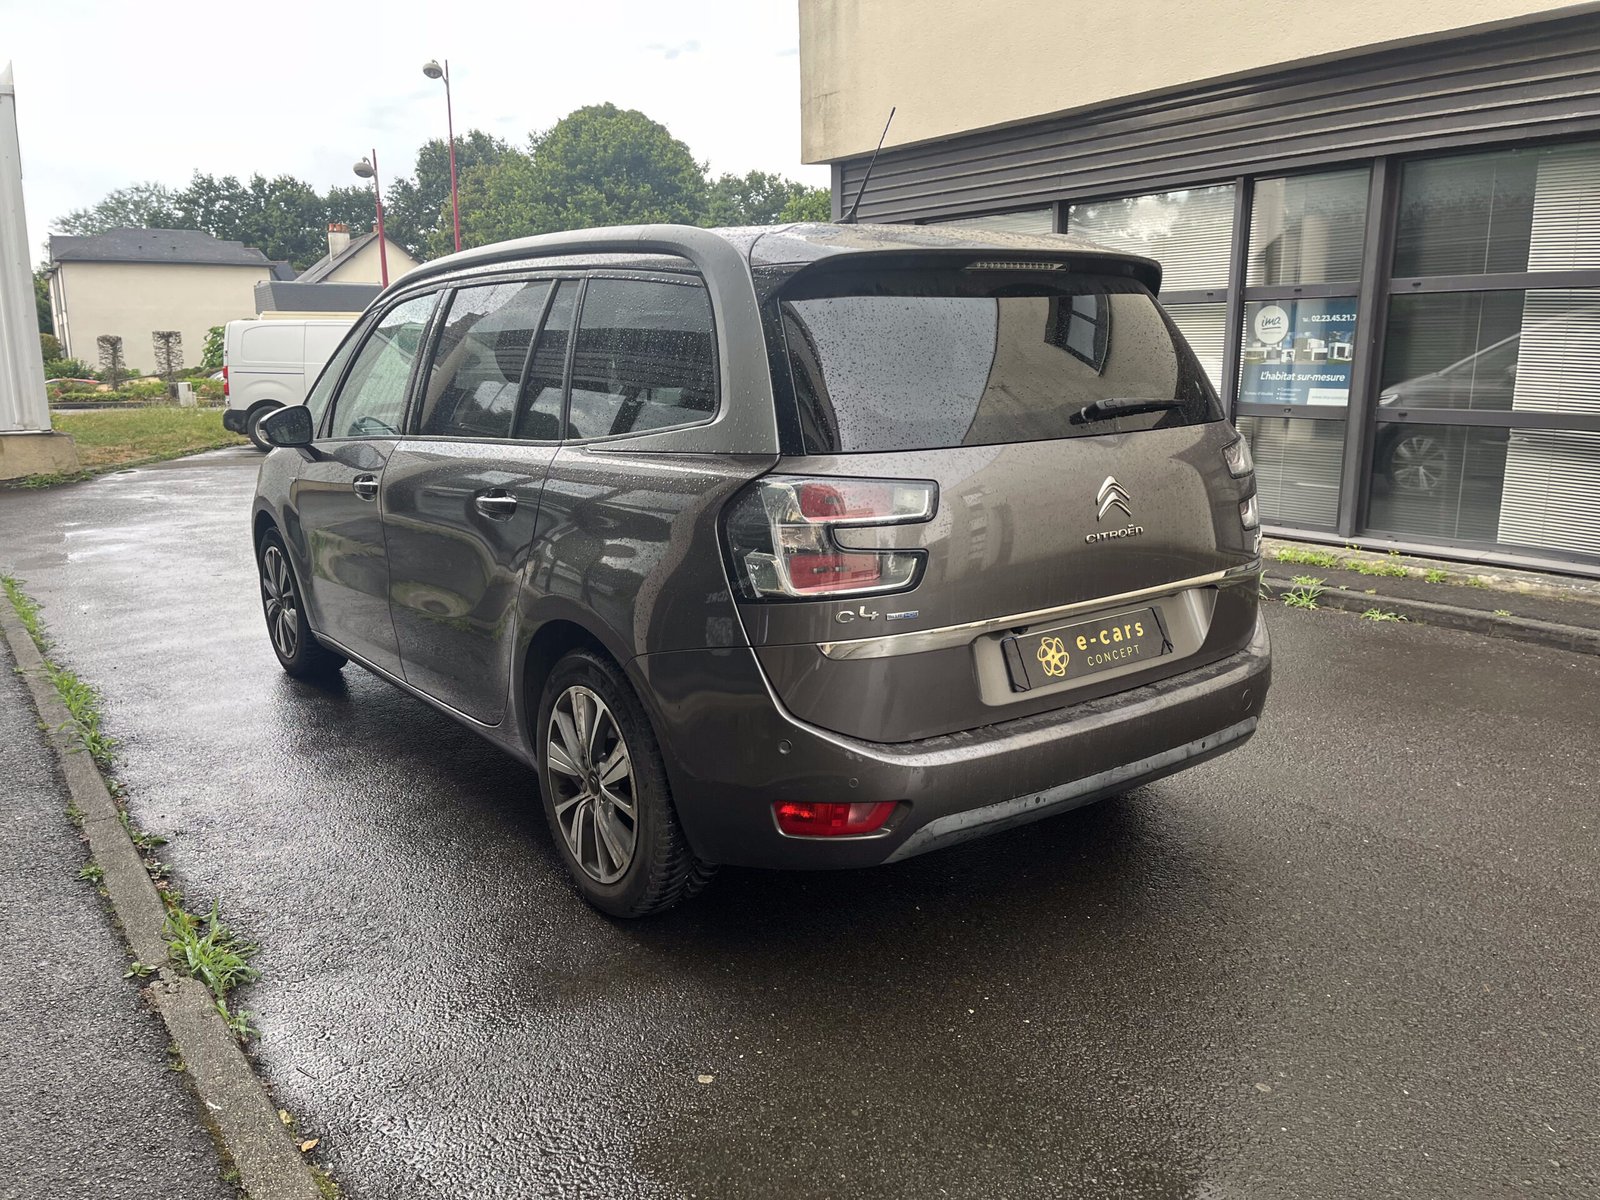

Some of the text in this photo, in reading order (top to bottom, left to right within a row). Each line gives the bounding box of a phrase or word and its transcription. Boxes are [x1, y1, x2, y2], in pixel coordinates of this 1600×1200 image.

[1261, 315, 1281, 327] ima
[1260, 371, 1346, 382] L'habitat sur-mesure
[1085, 524, 1144, 544] CITROËN
[835, 605, 880, 624] C4
[1076, 621, 1144, 650] e-cars
[1087, 644, 1140, 666] CONCEPT
